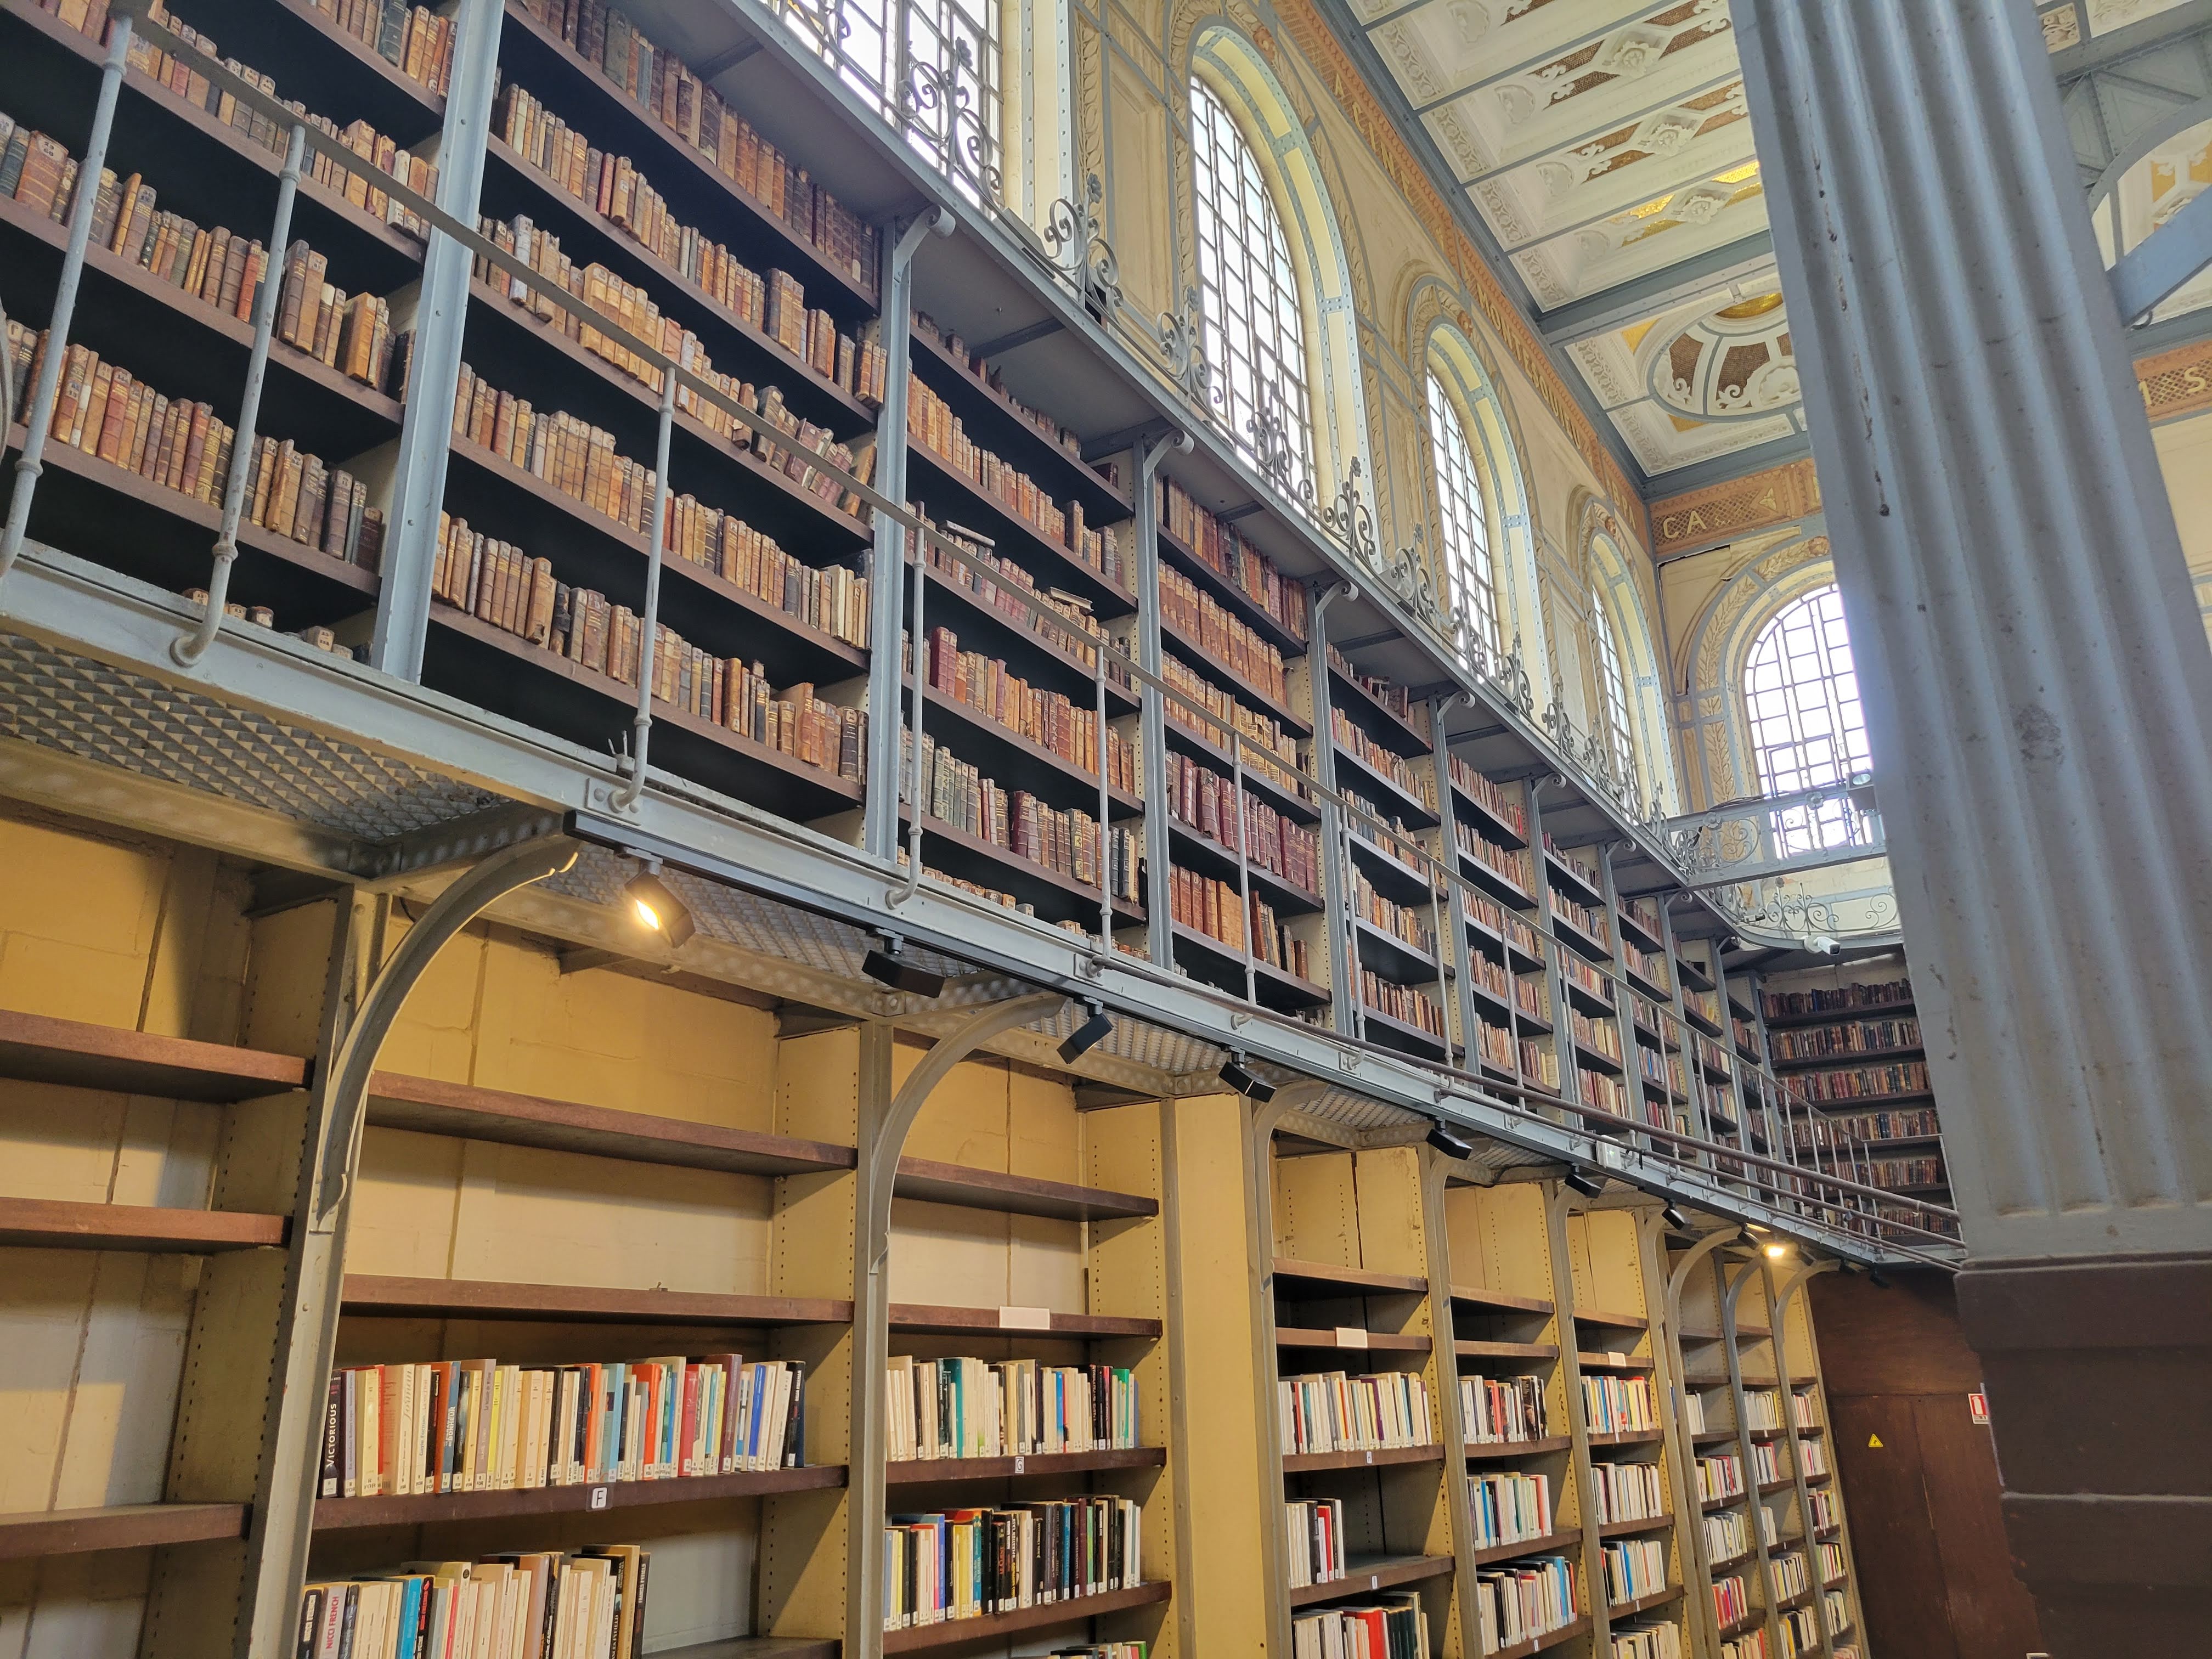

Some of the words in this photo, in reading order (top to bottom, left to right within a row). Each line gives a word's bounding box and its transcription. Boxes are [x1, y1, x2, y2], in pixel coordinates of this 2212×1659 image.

[1476, 283, 1581, 450] MONTESQUIEU
[326, 1403, 337, 1467] VICTORIOUS
[1017, 1459, 1023, 1471] G
[596, 1490, 604, 1506] F
[329, 1596, 340, 1626] FRENCH
[325, 1628, 335, 1650] NICCI
